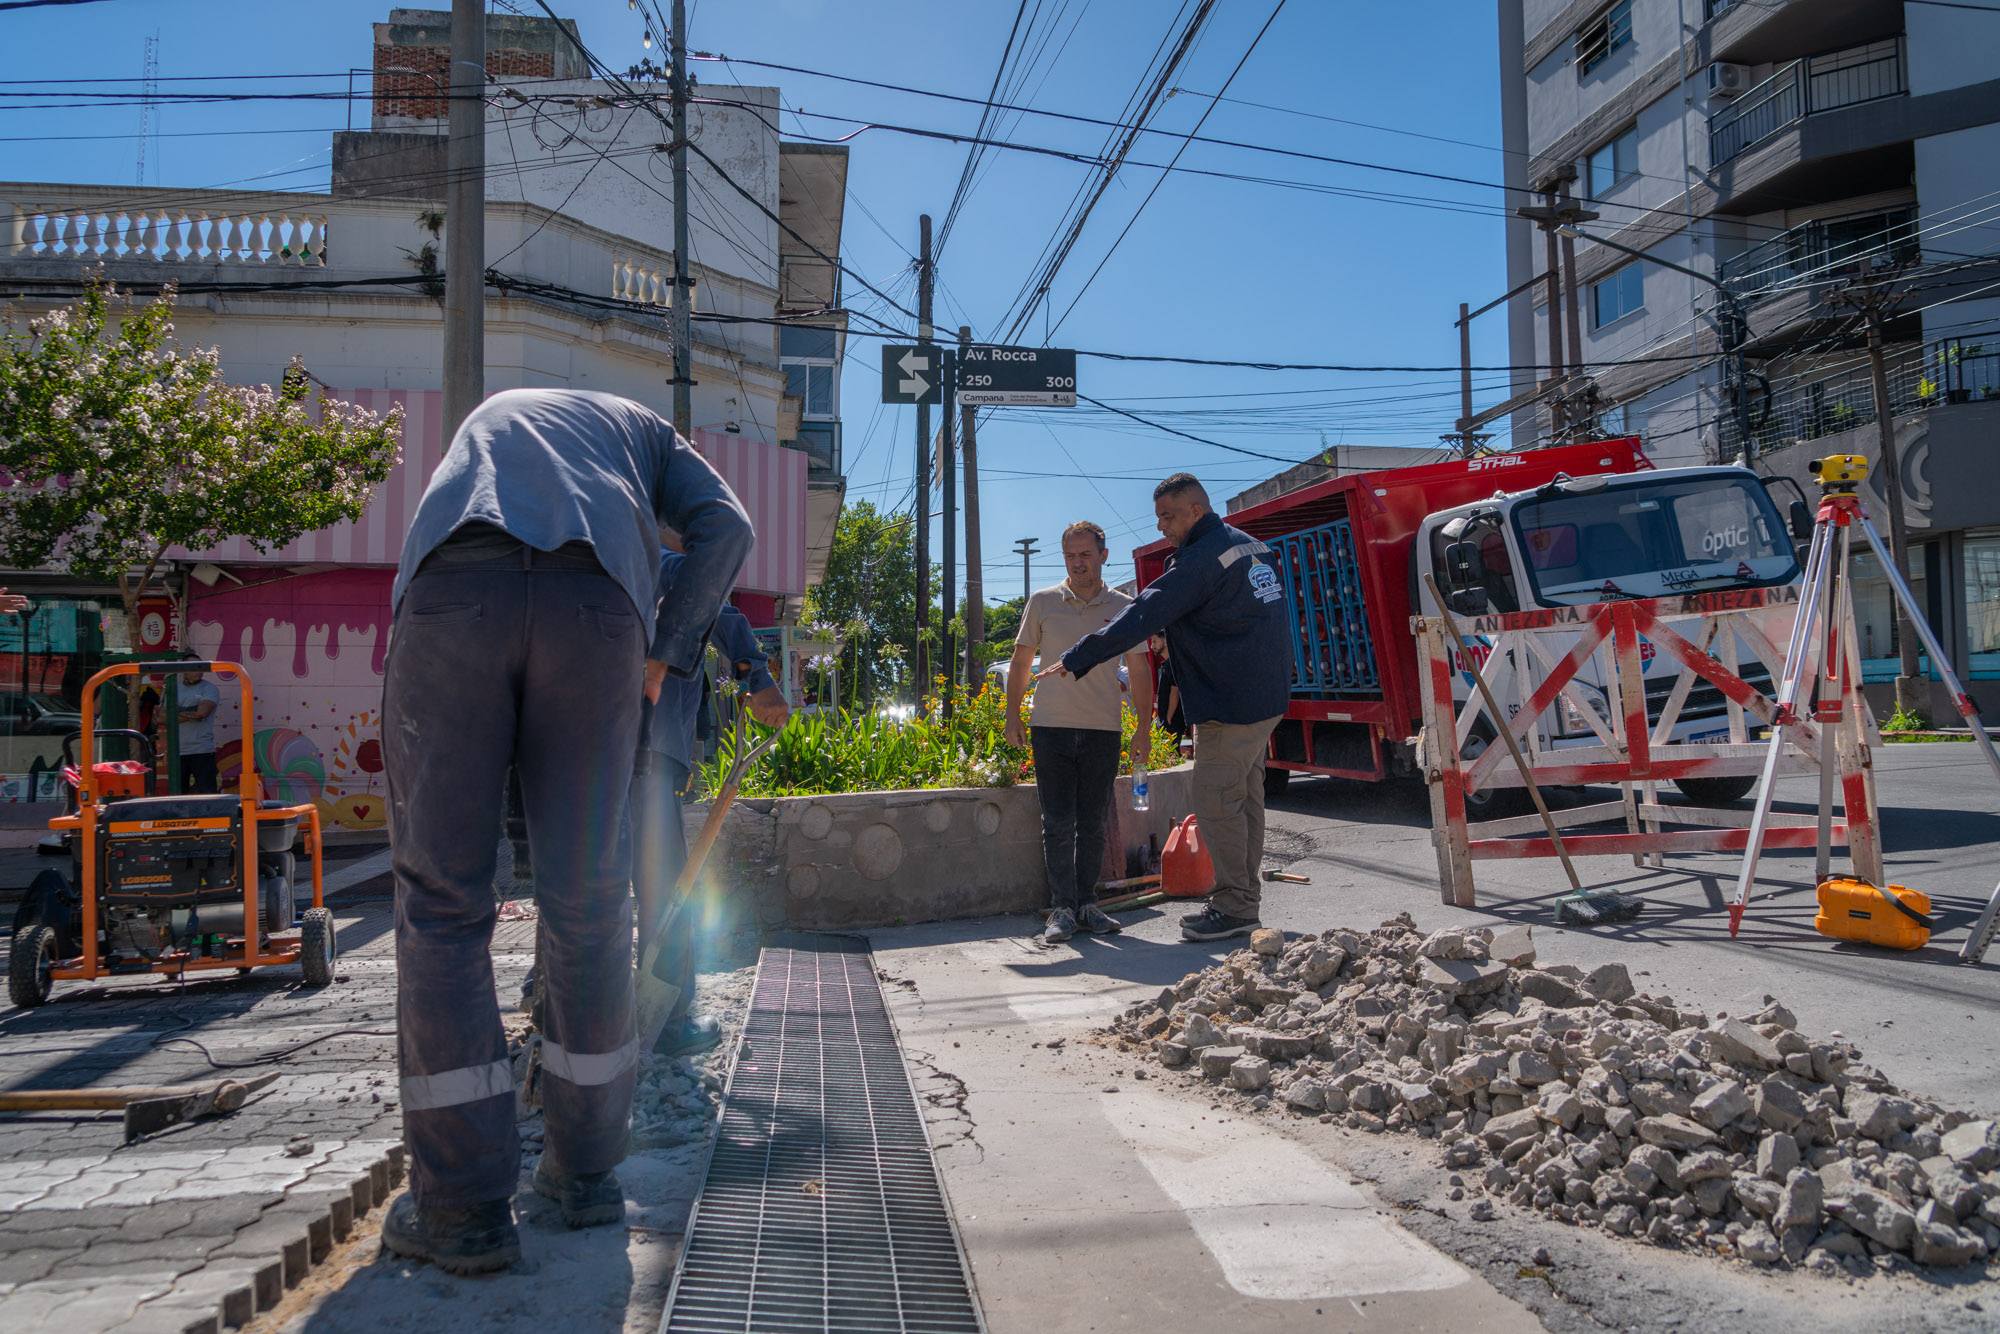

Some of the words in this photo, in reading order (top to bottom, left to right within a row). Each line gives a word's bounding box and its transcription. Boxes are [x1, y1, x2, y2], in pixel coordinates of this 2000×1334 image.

[964, 349, 987, 361] Av.
[991, 348, 1037, 362] Rocca
[965, 375, 992, 386] 250
[1046, 376, 1074, 388] 300
[963, 393, 1004, 402] Campana
[1702, 524, 1749, 555] óptic
[1660, 569, 1700, 584] MEGA
[1474, 606, 1580, 633] ANTEZANA
[146, 621, 160, 637] 福
